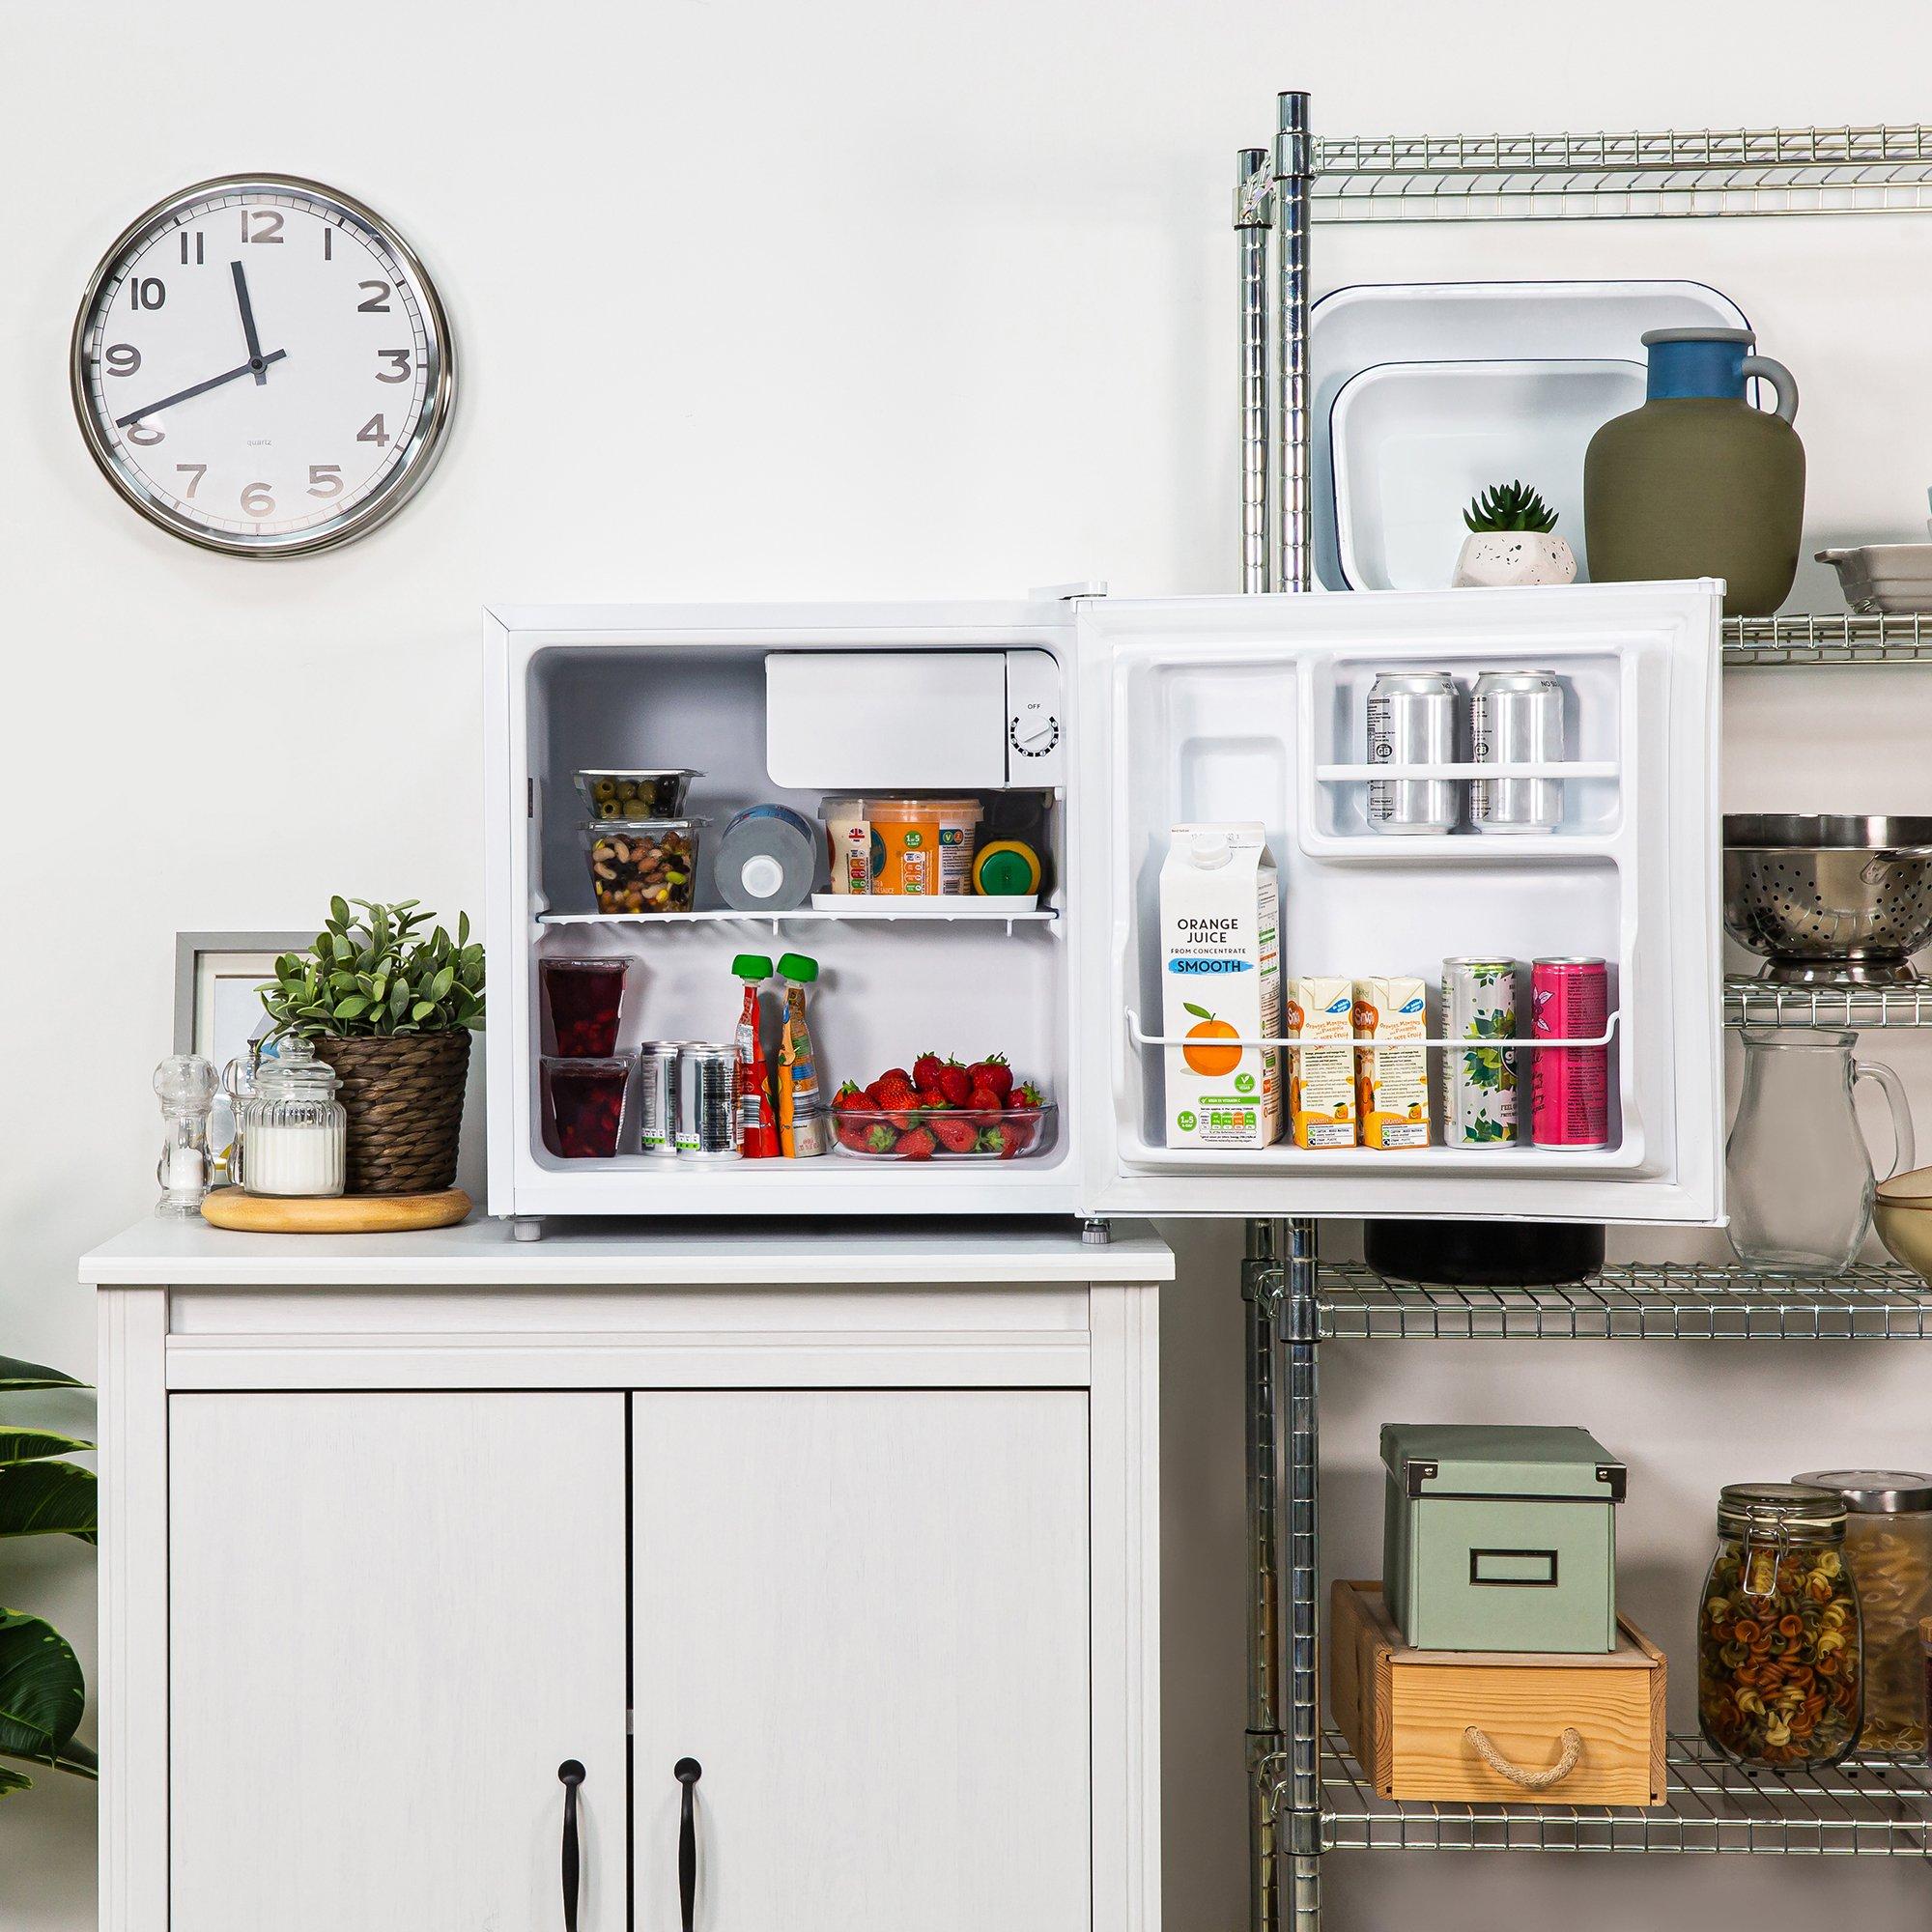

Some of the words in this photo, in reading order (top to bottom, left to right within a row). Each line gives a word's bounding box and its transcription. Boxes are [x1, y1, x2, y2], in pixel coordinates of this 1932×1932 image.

[241, 210, 284, 243] 12
[180, 231, 204, 265] 11
[324, 227, 331, 261] 1
[130, 277, 166, 310] 10
[356, 279, 391, 313] 2
[104, 343, 142, 377] 9
[374, 348, 412, 384] 3
[246, 438, 272, 447] quartz
[355, 412, 390, 447] 4
[176, 464, 207, 498] 7
[305, 464, 345, 498] 5
[240, 481, 276, 518] 6
[1377, 747, 1391, 755] GB
[1177, 918, 1238, 930] ORANGE
[1186, 932, 1227, 943] JUICE
[1177, 960, 1241, 973] SMOOTH
